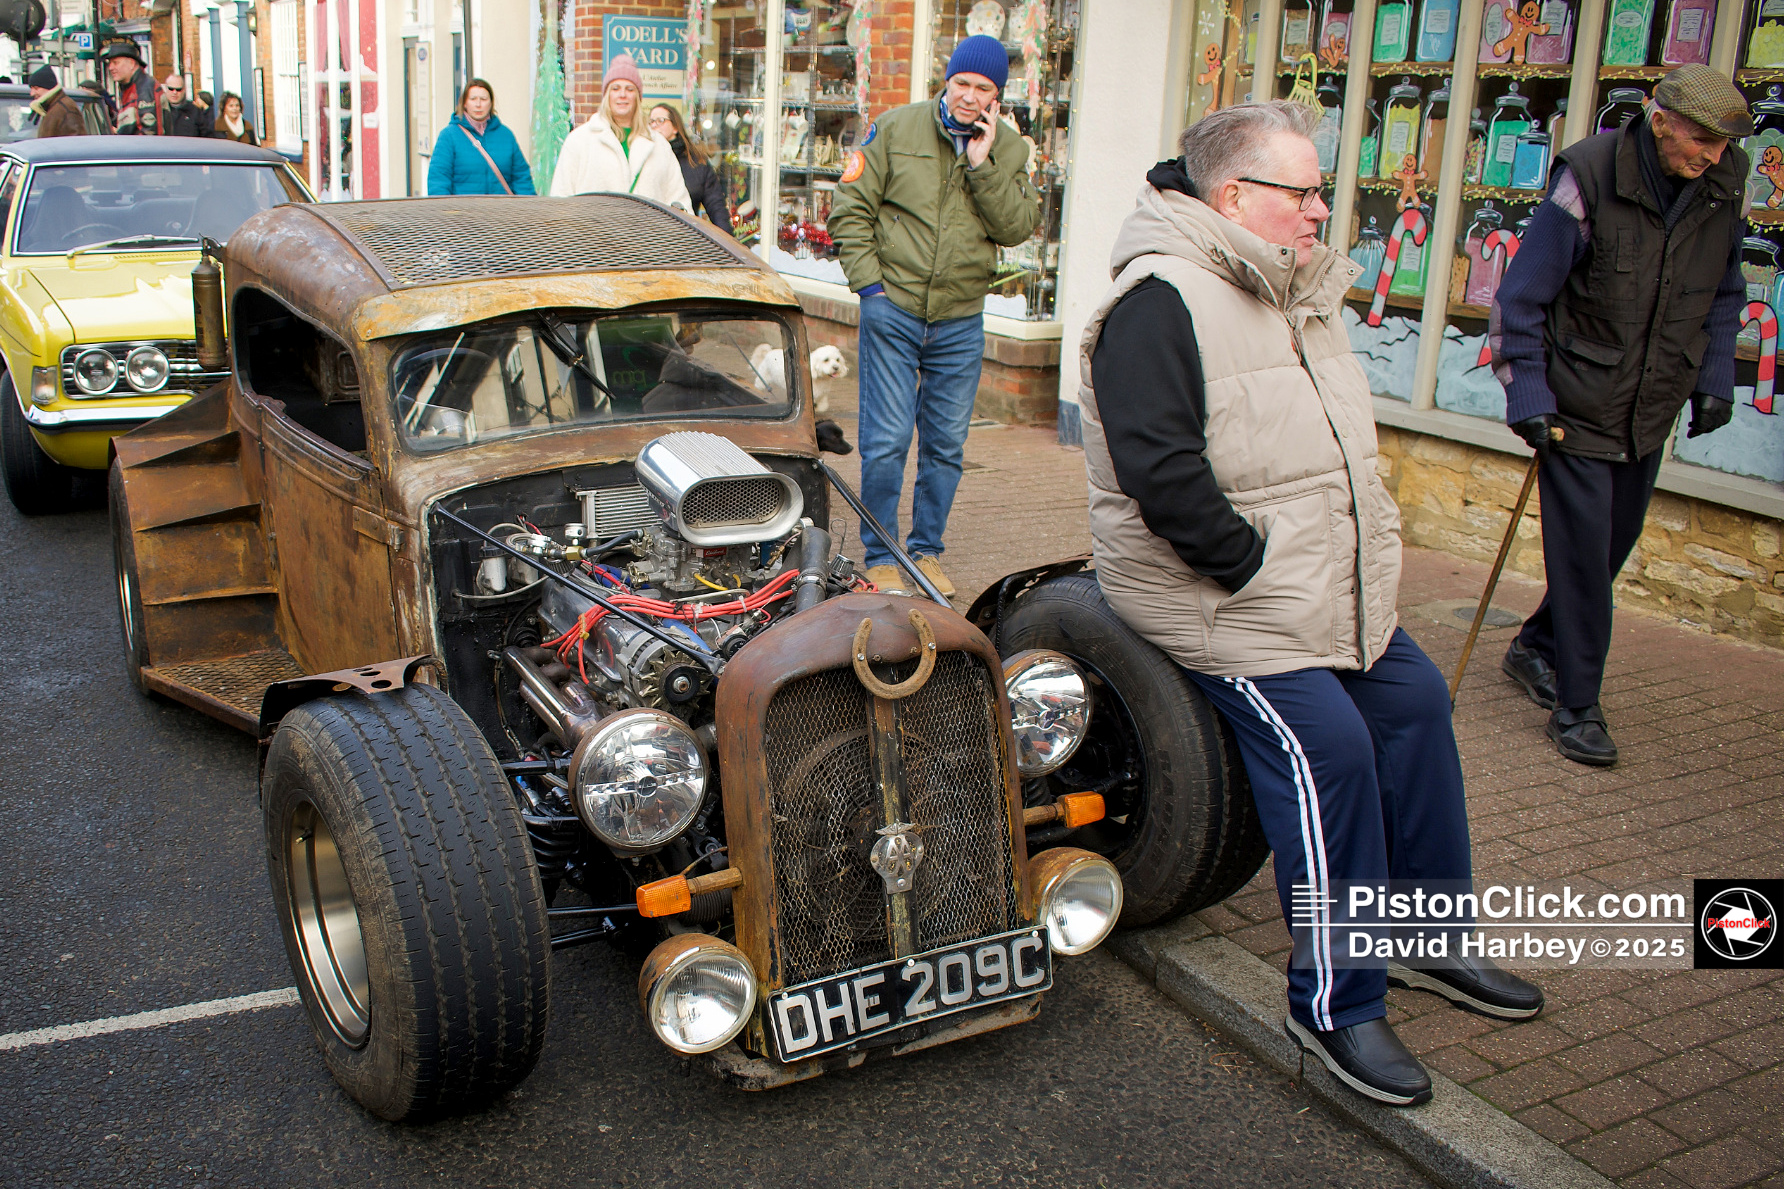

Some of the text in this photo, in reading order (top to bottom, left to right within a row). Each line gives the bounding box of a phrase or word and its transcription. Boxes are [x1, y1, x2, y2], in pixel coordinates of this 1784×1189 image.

[81, 35, 90, 47] P
[612, 25, 687, 44] ODELL'S
[623, 47, 679, 65] YARD
[885, 836, 914, 877] AA
[776, 936, 1045, 1054] DHE 209C
